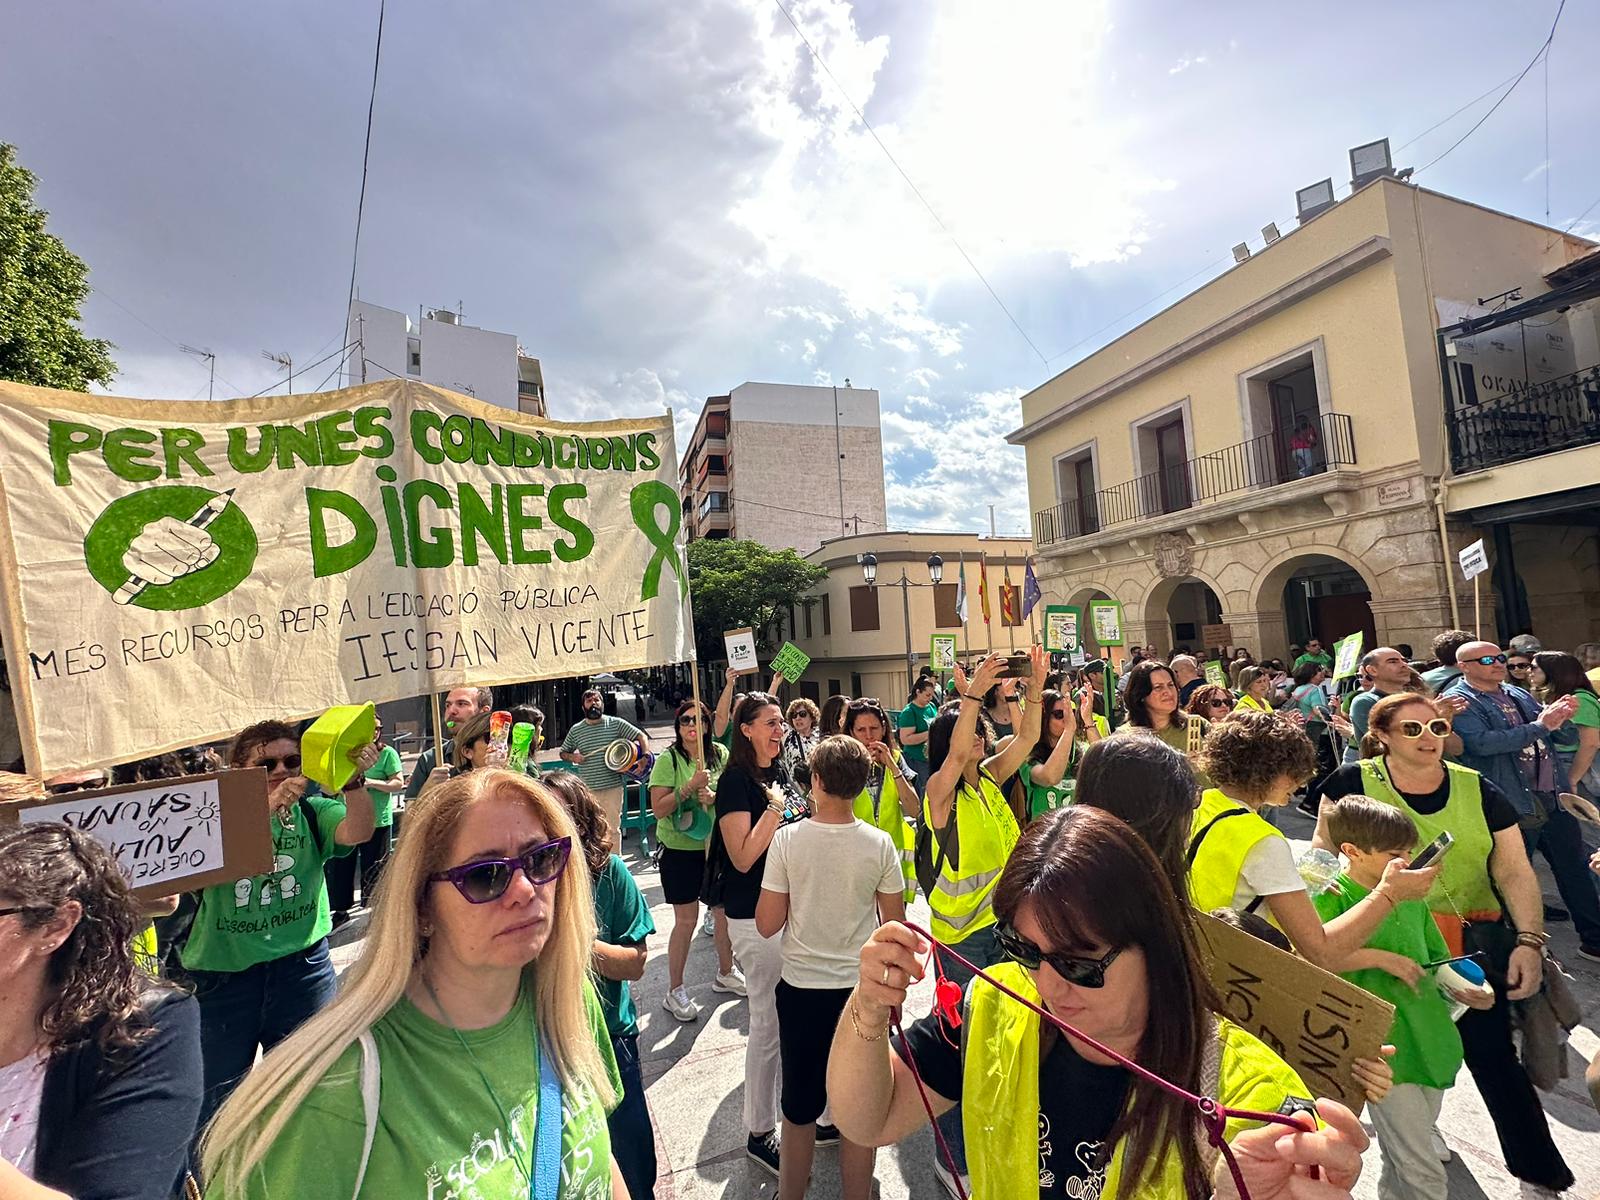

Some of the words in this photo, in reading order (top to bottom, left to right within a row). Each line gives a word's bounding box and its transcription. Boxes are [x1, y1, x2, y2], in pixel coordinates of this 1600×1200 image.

[48, 418, 216, 486] PER
[227, 406, 395, 474] UNES
[29, 640, 107, 680] MÉS
[121, 613, 264, 666] RECURSOS
[279, 603, 329, 633] PER
[338, 598, 357, 625] A
[367, 586, 479, 620] L'EDCACIÓ
[499, 583, 600, 613] PÚBLICA
[344, 628, 418, 682] IES
[425, 627, 499, 670] SAN
[520, 608, 655, 660] VICENTE
[62, 792, 192, 831] SAUNAS
[139, 816, 169, 833] NO
